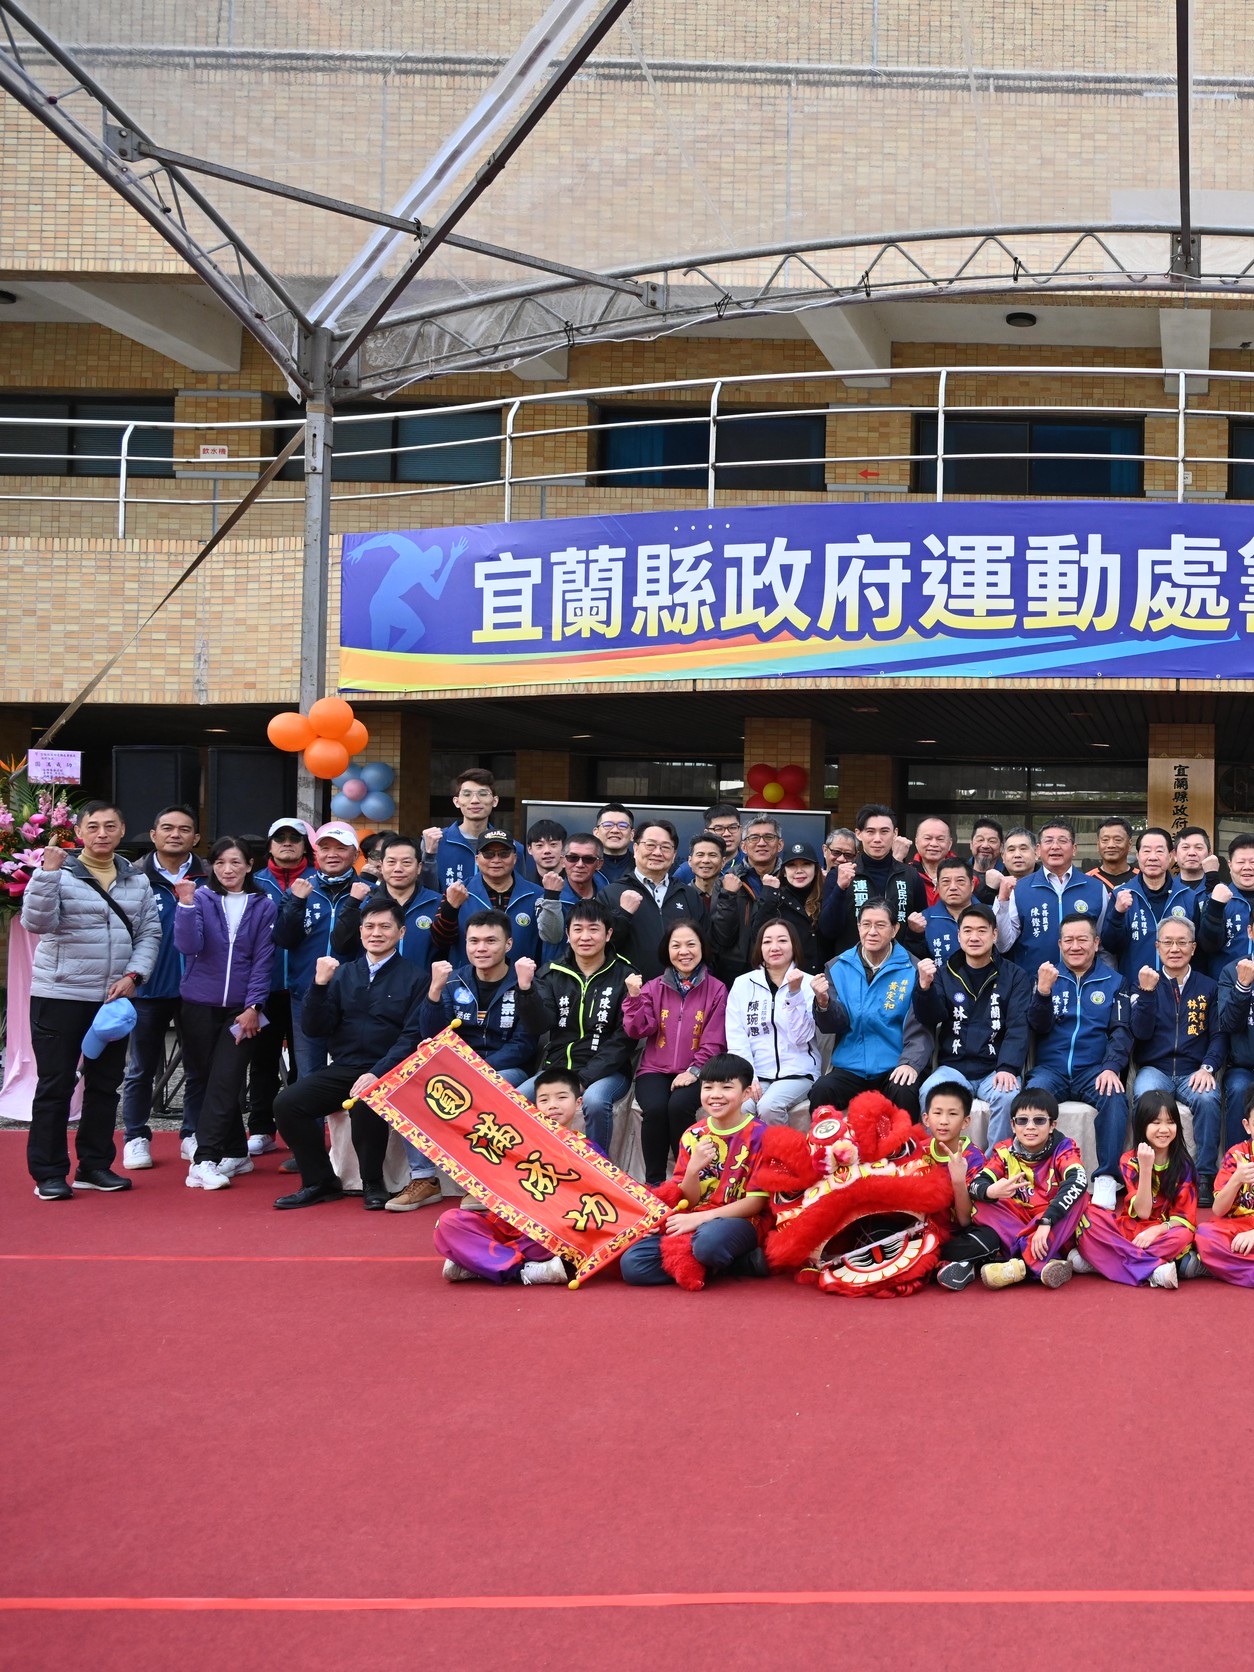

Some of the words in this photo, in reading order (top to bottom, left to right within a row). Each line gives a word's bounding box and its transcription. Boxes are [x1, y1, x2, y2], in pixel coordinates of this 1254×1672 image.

[202, 447, 227, 456] 飲水機
[1171, 764, 1190, 845] 宜蘭縣政府
[895, 880, 908, 923] 市民代表
[425, 1074, 618, 1231] 圓滿成功
[1058, 1183, 1083, 1210] LOCK
